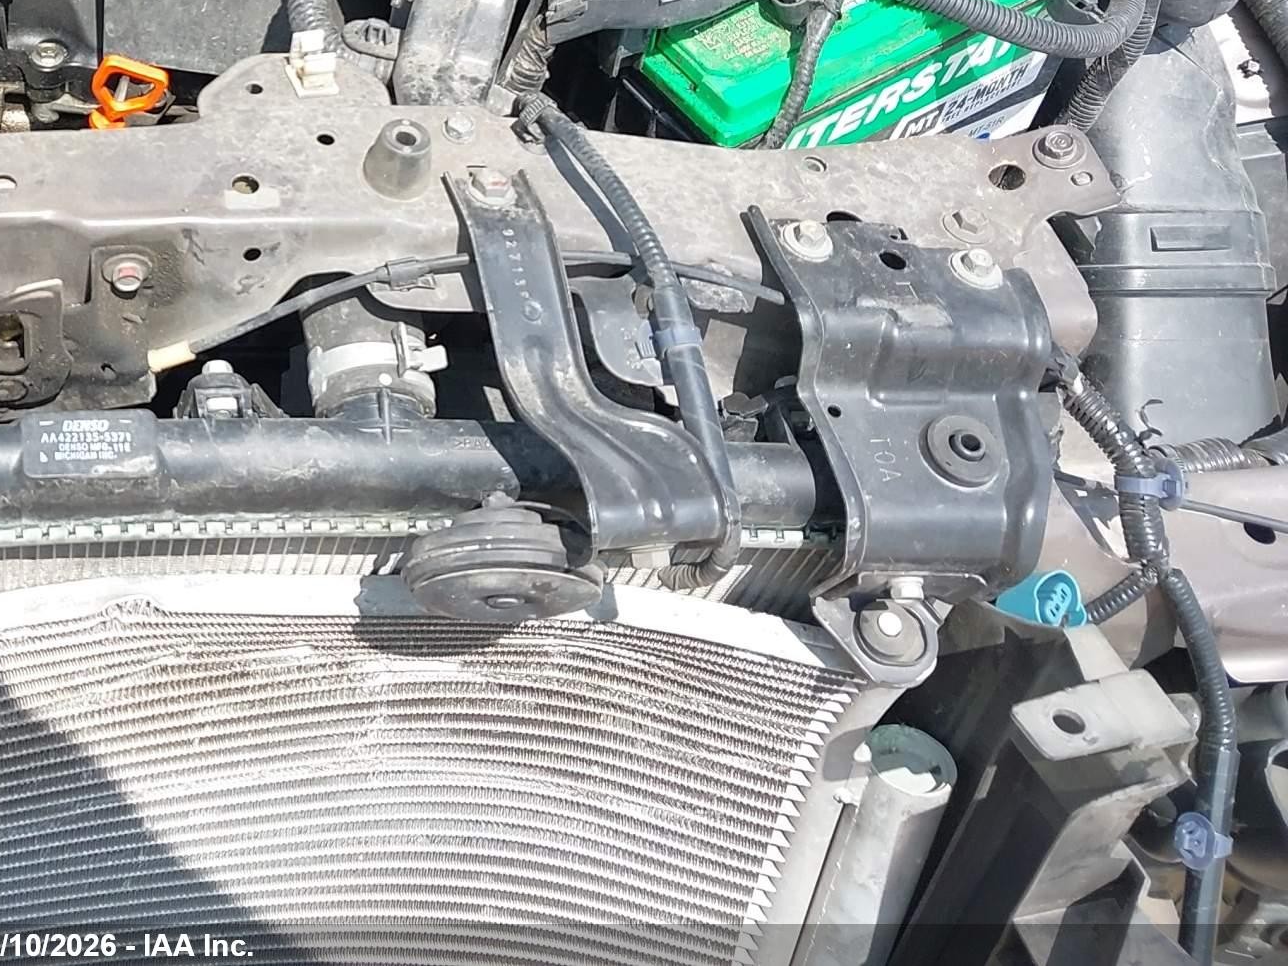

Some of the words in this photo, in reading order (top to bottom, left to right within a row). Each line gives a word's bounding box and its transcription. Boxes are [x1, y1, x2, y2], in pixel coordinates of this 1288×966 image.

[781, 35, 1011, 150] TERSTA
[944, 64, 1031, 115] 24-MONTH
[906, 110, 942, 135] MT
[63, 420, 109, 432] DENSO
[58, 442, 88, 451] DENSO
